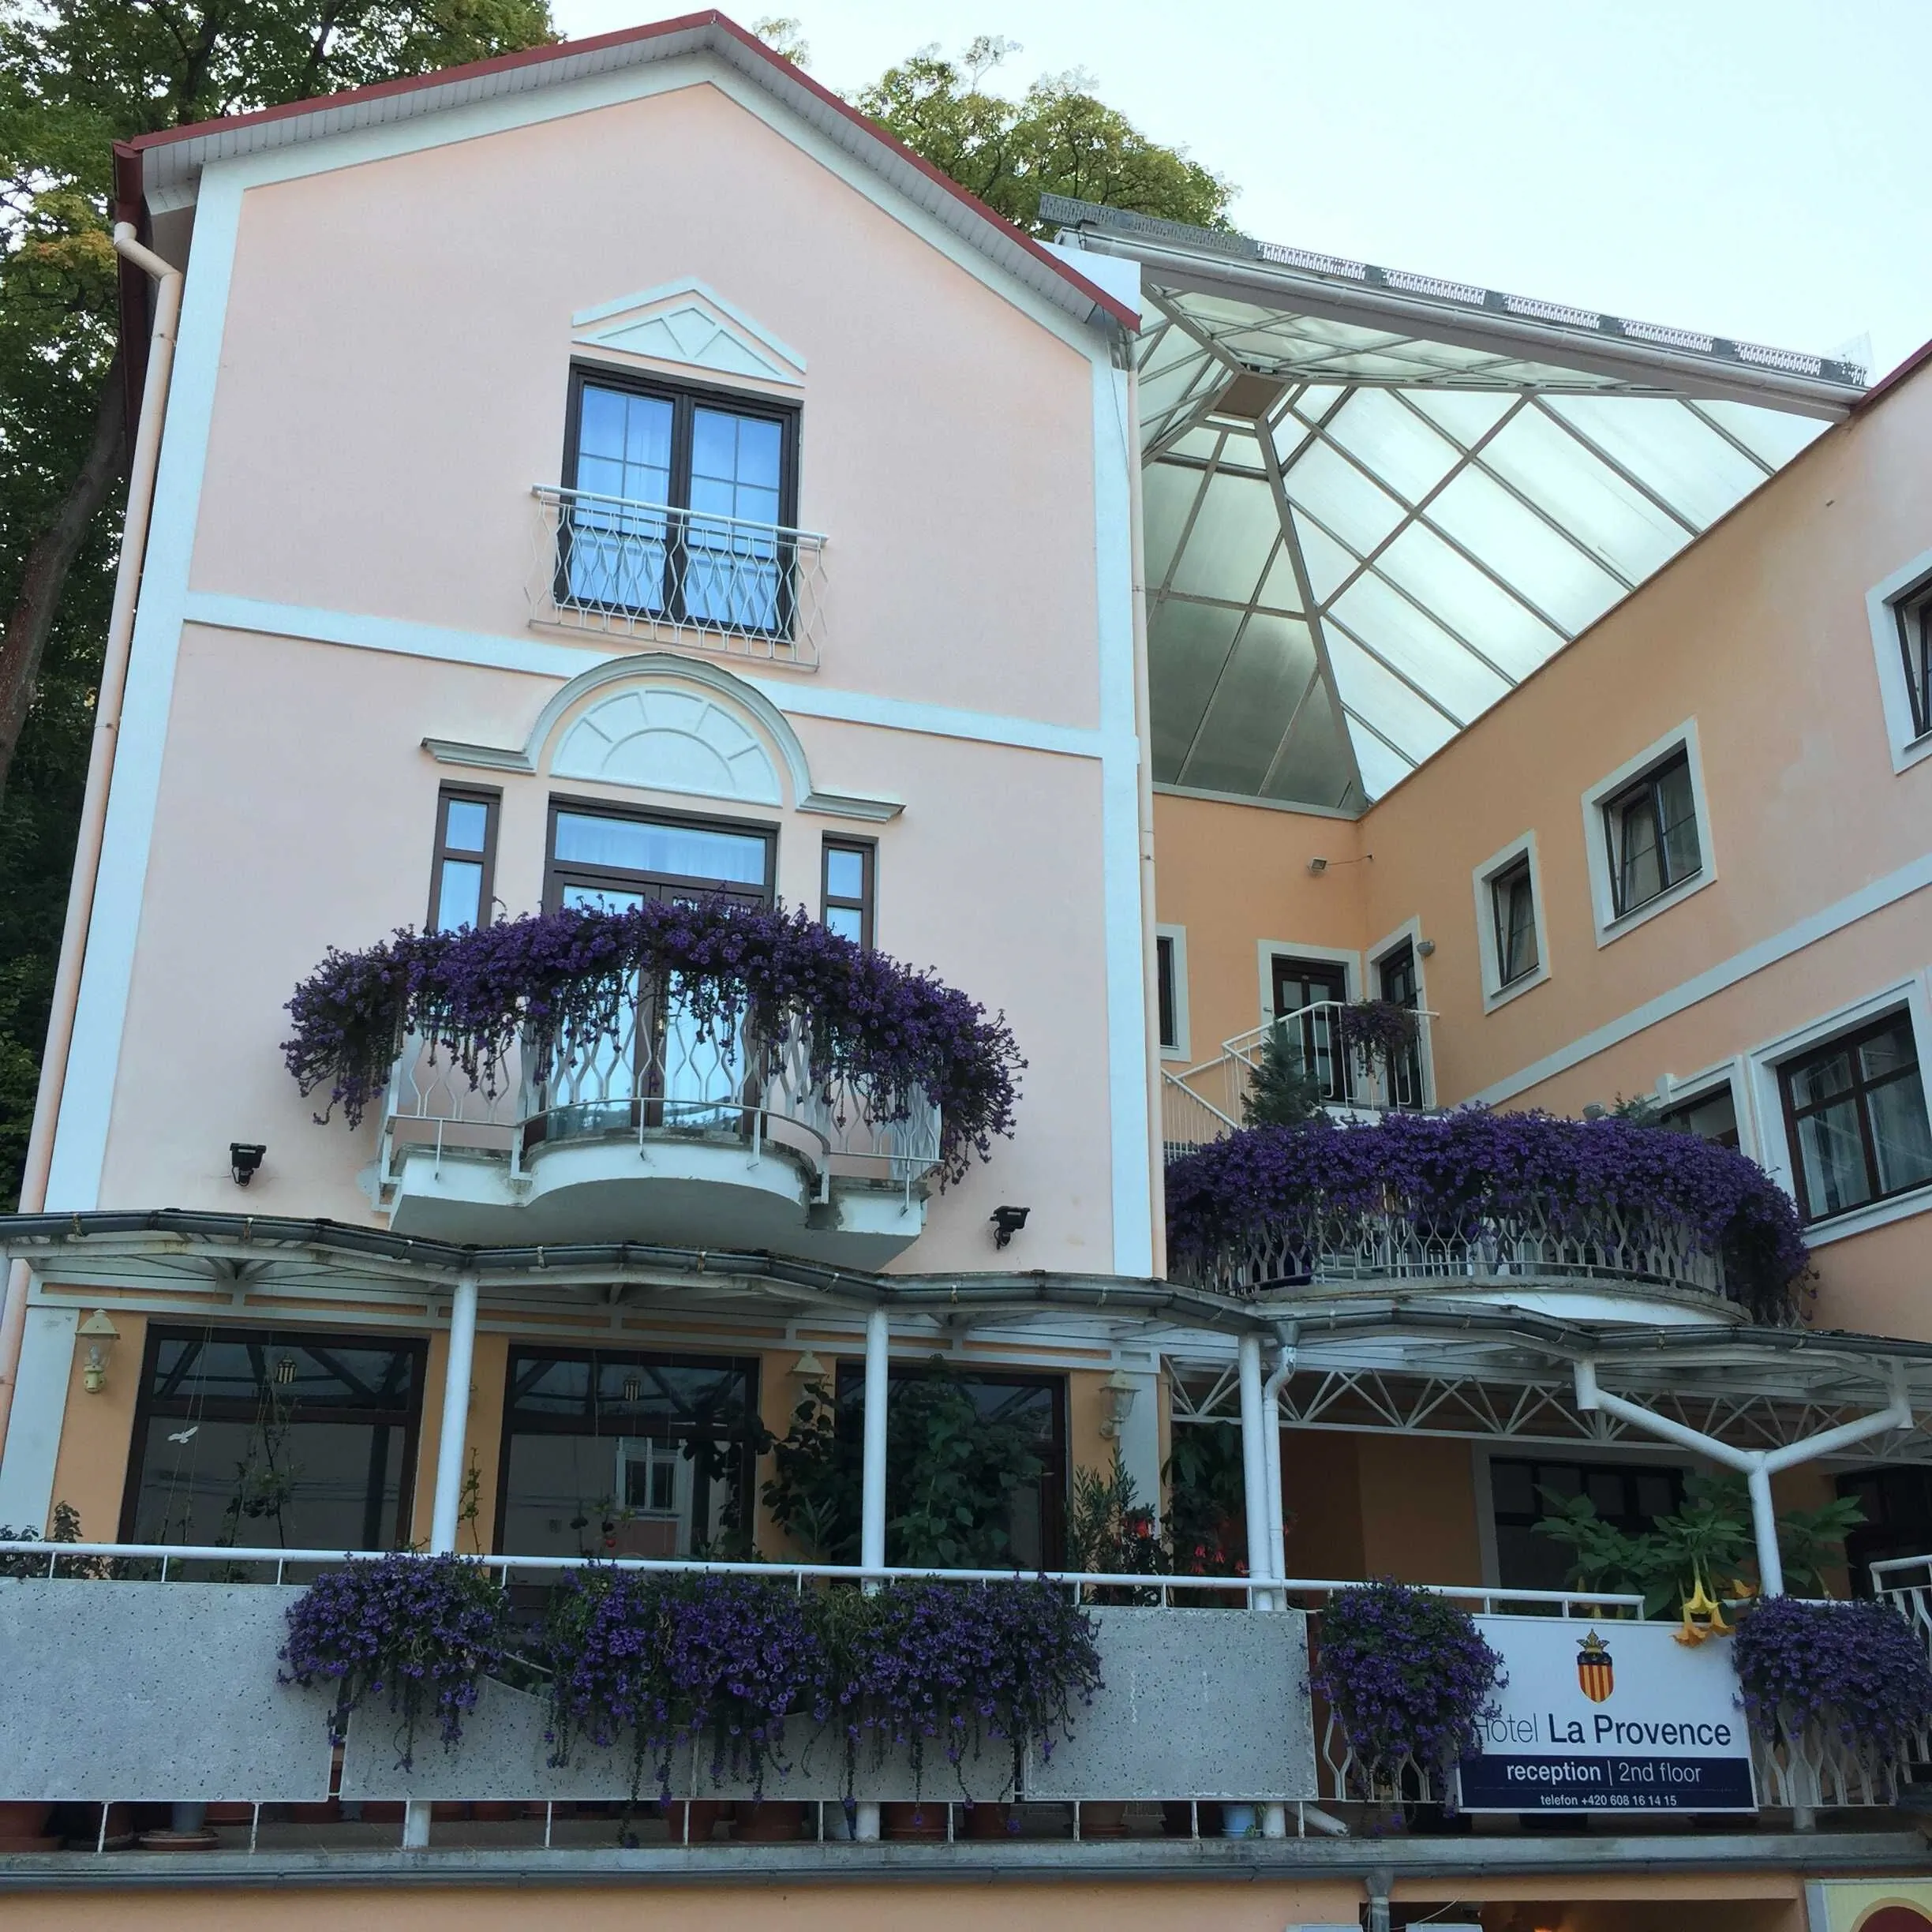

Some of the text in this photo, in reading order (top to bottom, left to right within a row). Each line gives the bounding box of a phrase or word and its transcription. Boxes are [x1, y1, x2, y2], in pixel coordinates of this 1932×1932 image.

[1548, 1713, 1586, 1743] La
[1594, 1714, 1731, 1746] Provence
[1507, 1762, 1702, 1785] reception 2nd floor
[1541, 1794, 1677, 1807] telefon +420 608 16 14 15
